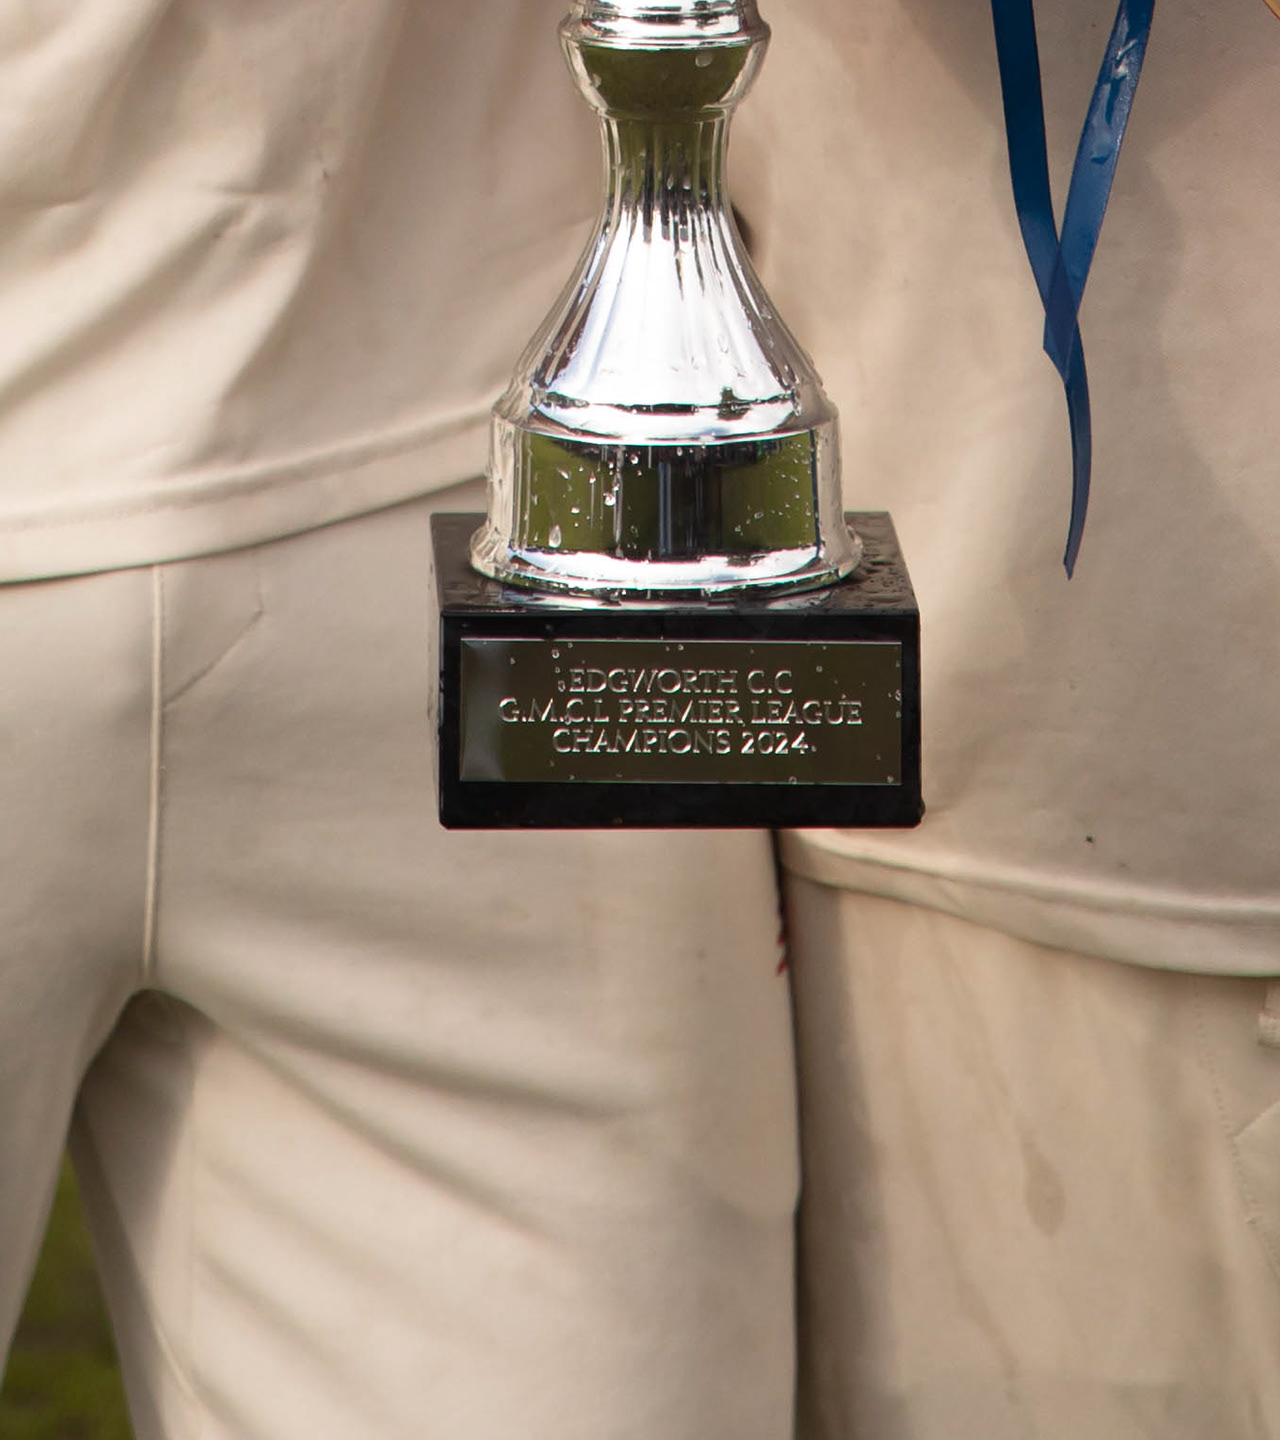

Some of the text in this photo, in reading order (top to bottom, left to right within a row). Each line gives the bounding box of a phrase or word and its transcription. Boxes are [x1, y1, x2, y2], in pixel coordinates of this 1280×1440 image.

[569, 668, 793, 694] EDGWORTH C.C
[499, 697, 863, 725] G.M.C.L PREMIER LEAGUE
[552, 728, 809, 755] CHAMPIONS 2024
